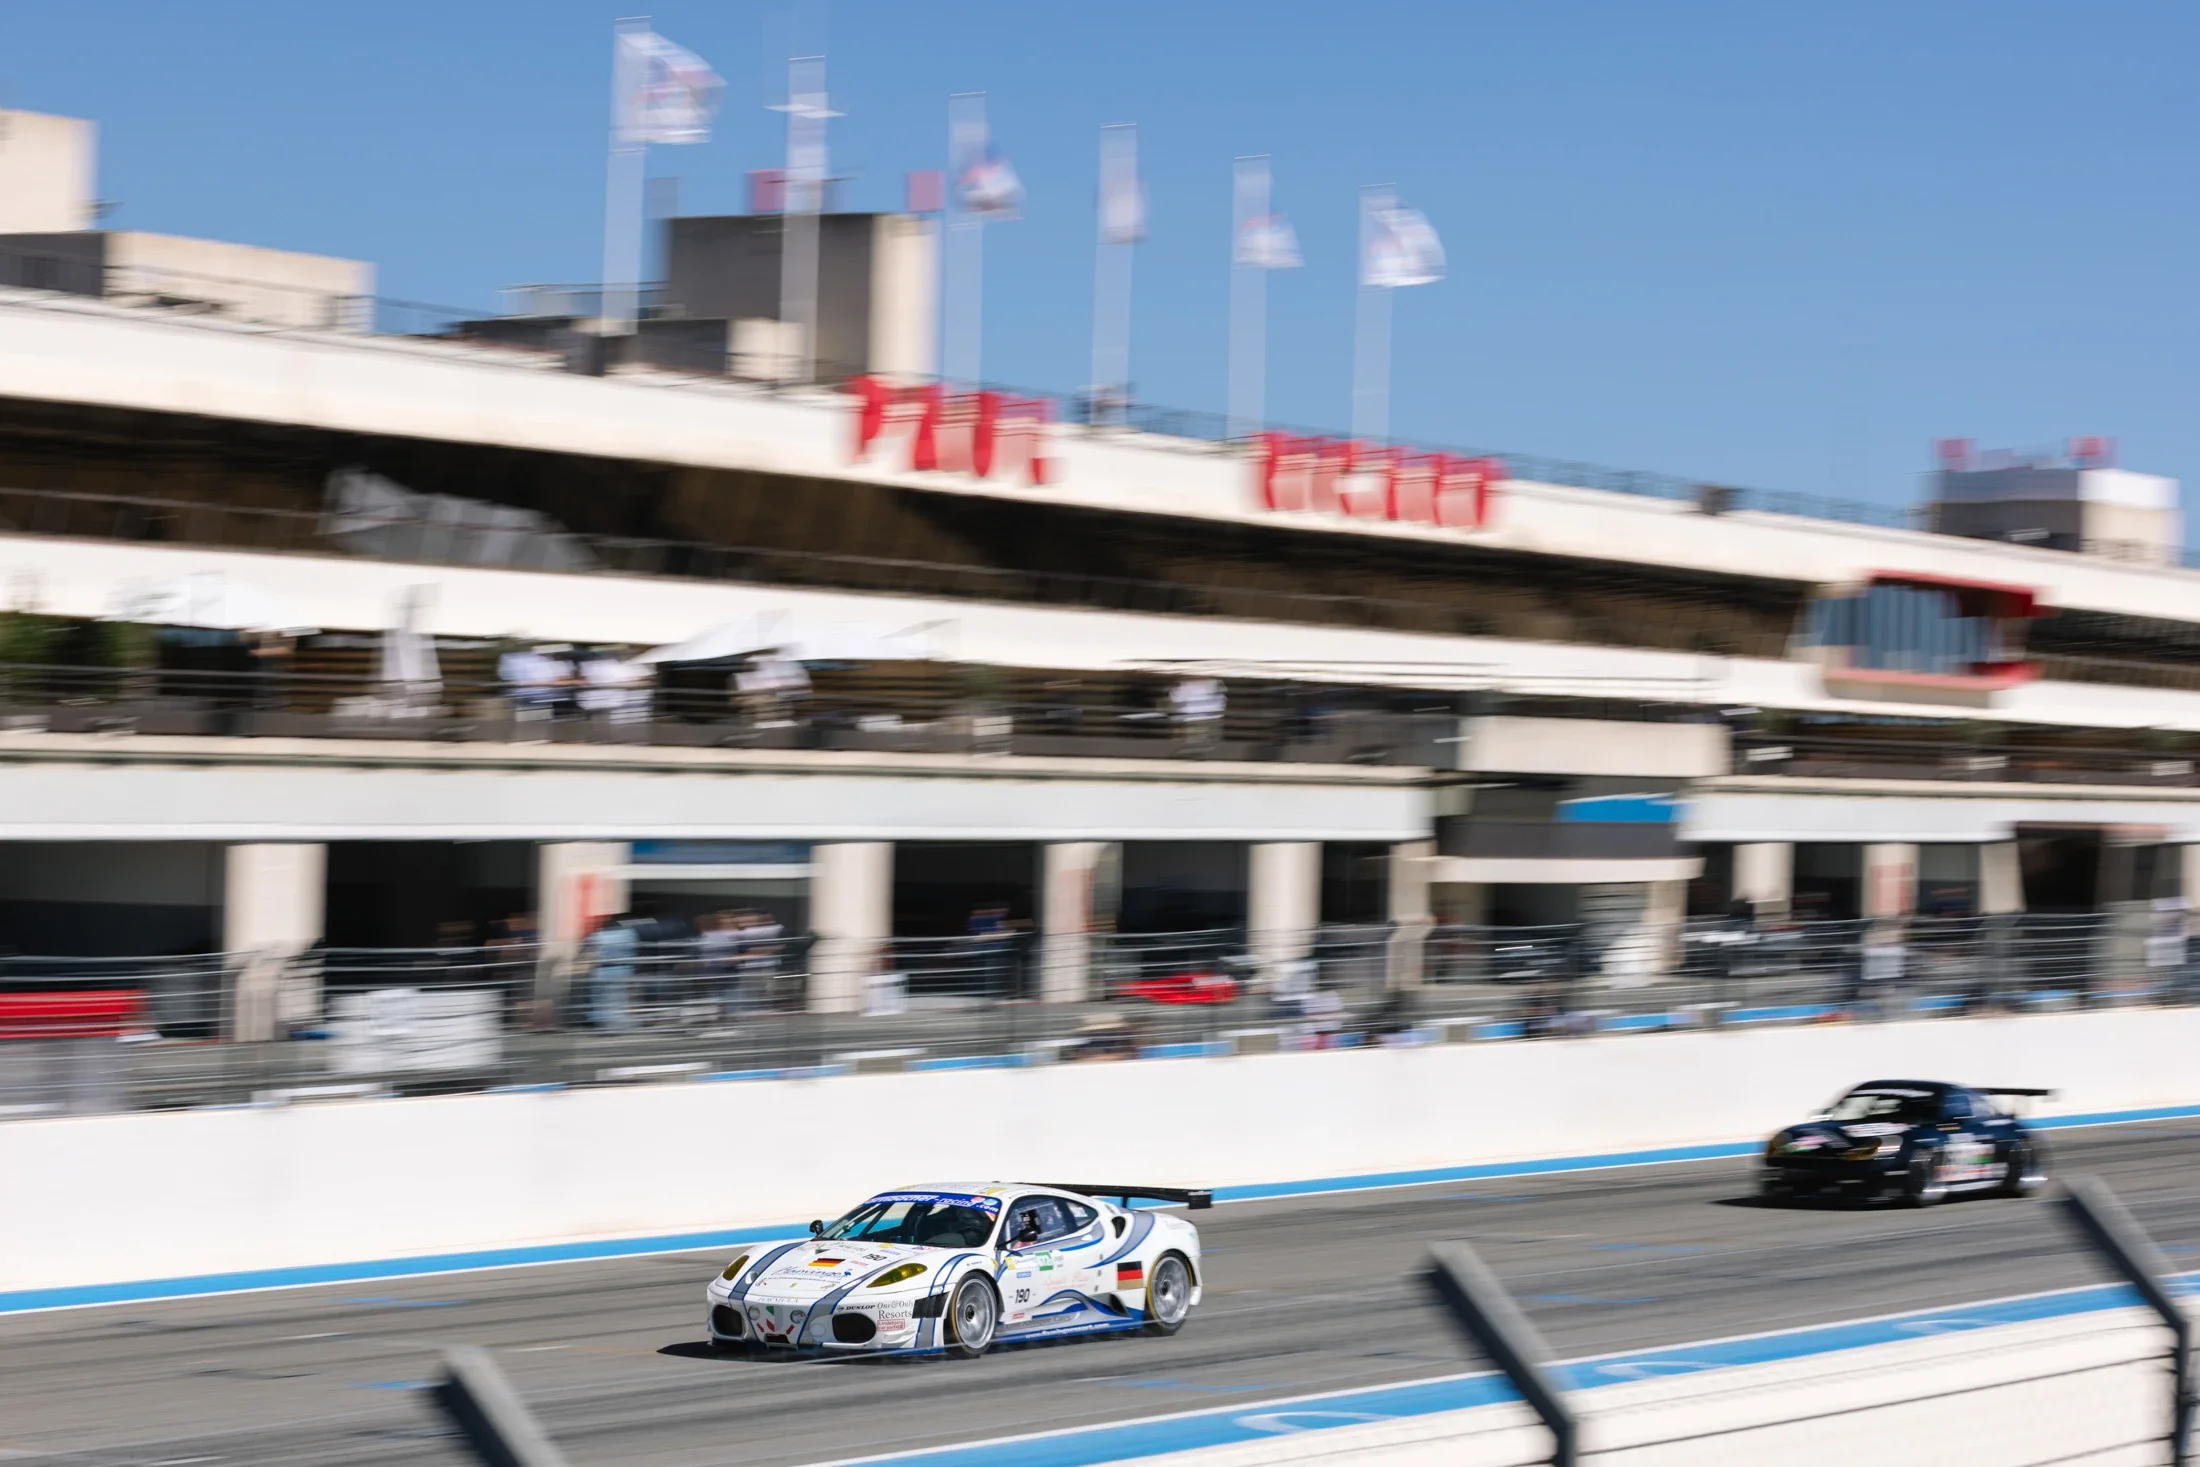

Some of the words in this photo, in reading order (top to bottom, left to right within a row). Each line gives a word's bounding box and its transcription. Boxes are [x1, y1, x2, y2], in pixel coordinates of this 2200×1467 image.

[1015, 1288, 1030, 1303] 190
[876, 1300, 914, 1309] One&Only
[878, 1310, 912, 1319] Resorts
